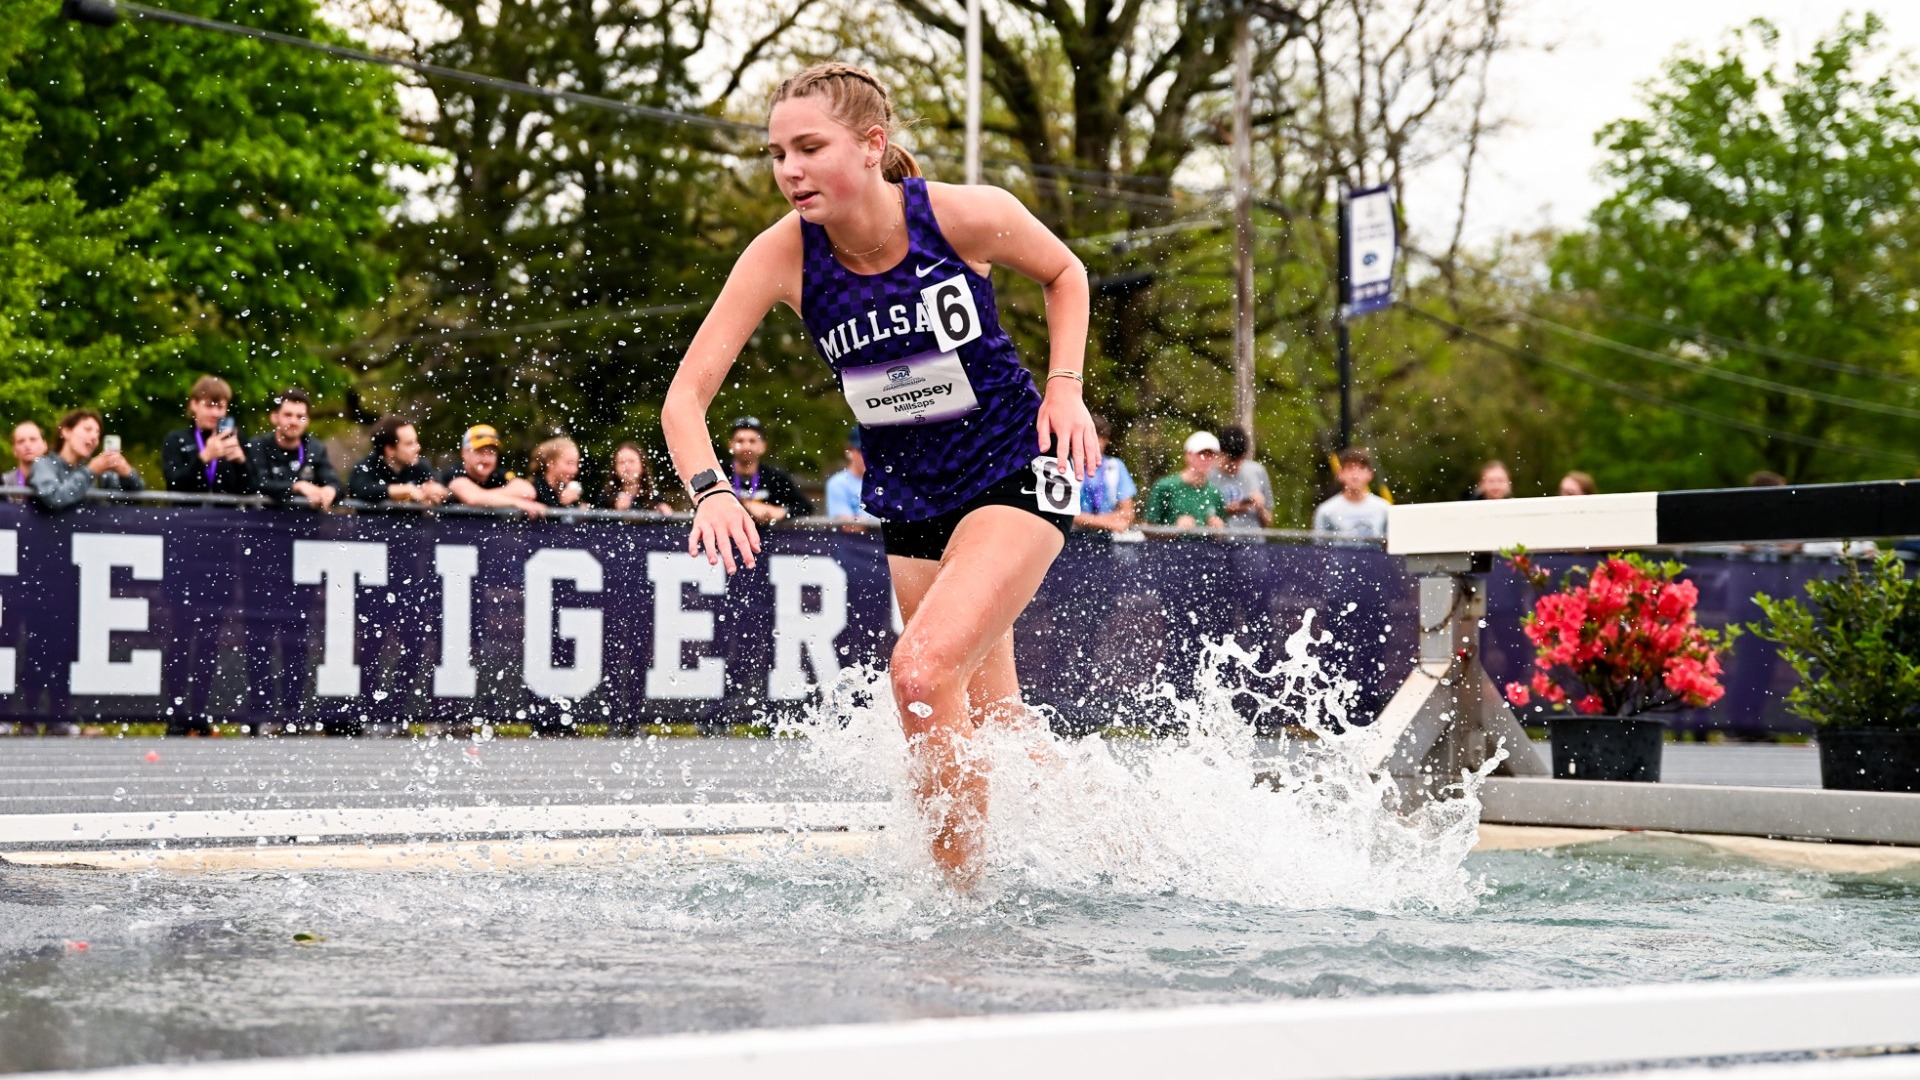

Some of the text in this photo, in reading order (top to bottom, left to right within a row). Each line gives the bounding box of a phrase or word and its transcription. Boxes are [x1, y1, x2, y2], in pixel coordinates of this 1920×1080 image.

[819, 302, 934, 363] MILLSA
[936, 285, 971, 342] 6
[865, 383, 953, 409] Dempsey
[891, 370, 911, 381] SAA
[894, 398, 936, 413] Millsaps
[1042, 461, 1072, 510] 6
[0, 529, 905, 700] E TIGER
